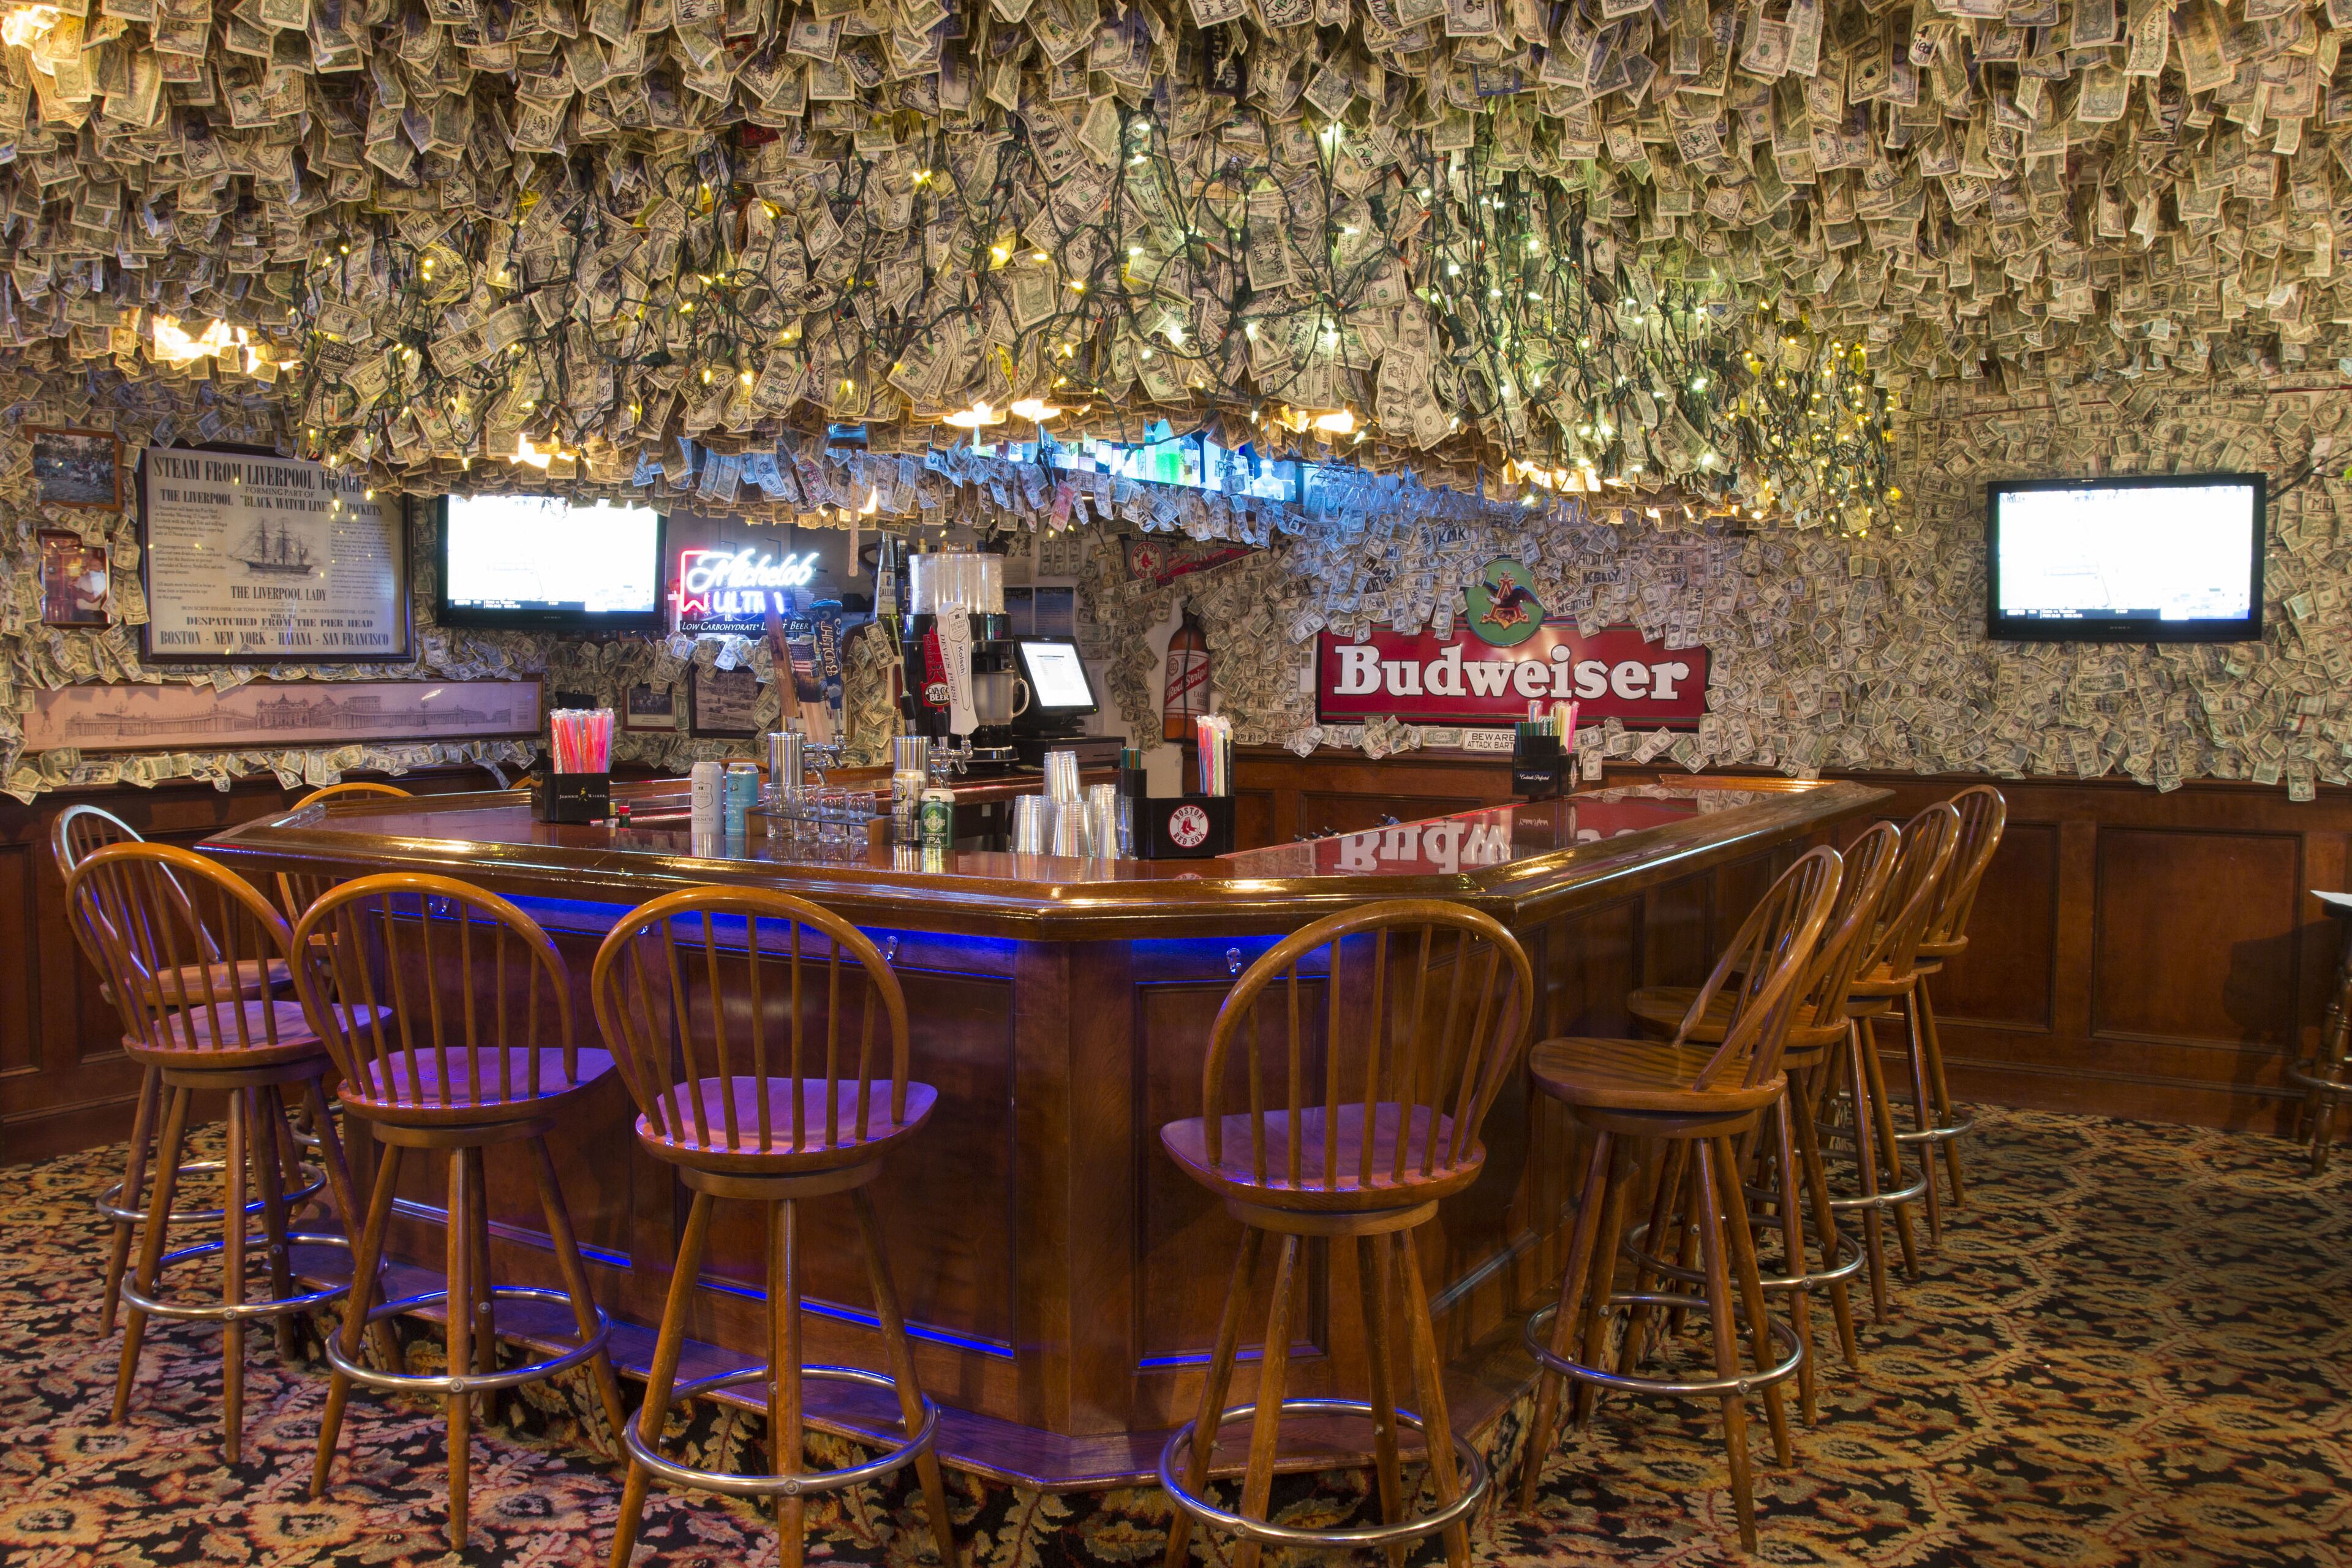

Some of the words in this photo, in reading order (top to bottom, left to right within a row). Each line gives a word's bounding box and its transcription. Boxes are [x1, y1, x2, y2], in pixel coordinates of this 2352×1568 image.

[1356, 148, 1376, 168] EVER
[154, 456, 199, 480] STEAM
[205, 461, 241, 484] FROM
[247, 464, 315, 490] LIVERPOOL
[245, 486, 284, 497] FORMING
[284, 489, 302, 497] PART
[160, 489, 179, 502] THE
[184, 491, 233, 506] LIVERPOOL
[276, 497, 305, 511] WATCH
[347, 503, 382, 516] PACKETS
[1134, 544, 1158, 559] BOSTON
[1578, 553, 1614, 565] AUSTIN
[686, 548, 820, 594] Michelob
[1583, 570, 1620, 584] KELLY
[231, 586, 249, 598] THE
[254, 586, 303, 600] LIVERPOOL
[306, 589, 326, 601] LADY
[186, 616, 257, 627] DESPATCHED
[262, 617, 291, 627] FROM
[295, 618, 316, 627] THE
[320, 619, 343, 628] PIER
[347, 619, 373, 628] HEAD
[682, 621, 700, 631] LOW
[160, 630, 201, 646] BOSTON
[214, 631, 234, 646] NEW
[239, 631, 266, 646] YORK
[278, 631, 312, 646] HAVANA
[323, 633, 339, 646] SAN
[343, 633, 389, 646] FRANCISCO
[957, 645, 966, 674] Kolsch
[1333, 644, 1691, 700] Budweiser
[930, 693, 950, 702] BEER
[1166, 679, 1183, 701] Red
[1471, 733, 1515, 741] BEWARE
[1173, 807, 1205, 821] BOSTON
[1172, 831, 1188, 846] RED
[1190, 831, 1205, 846] SOX
